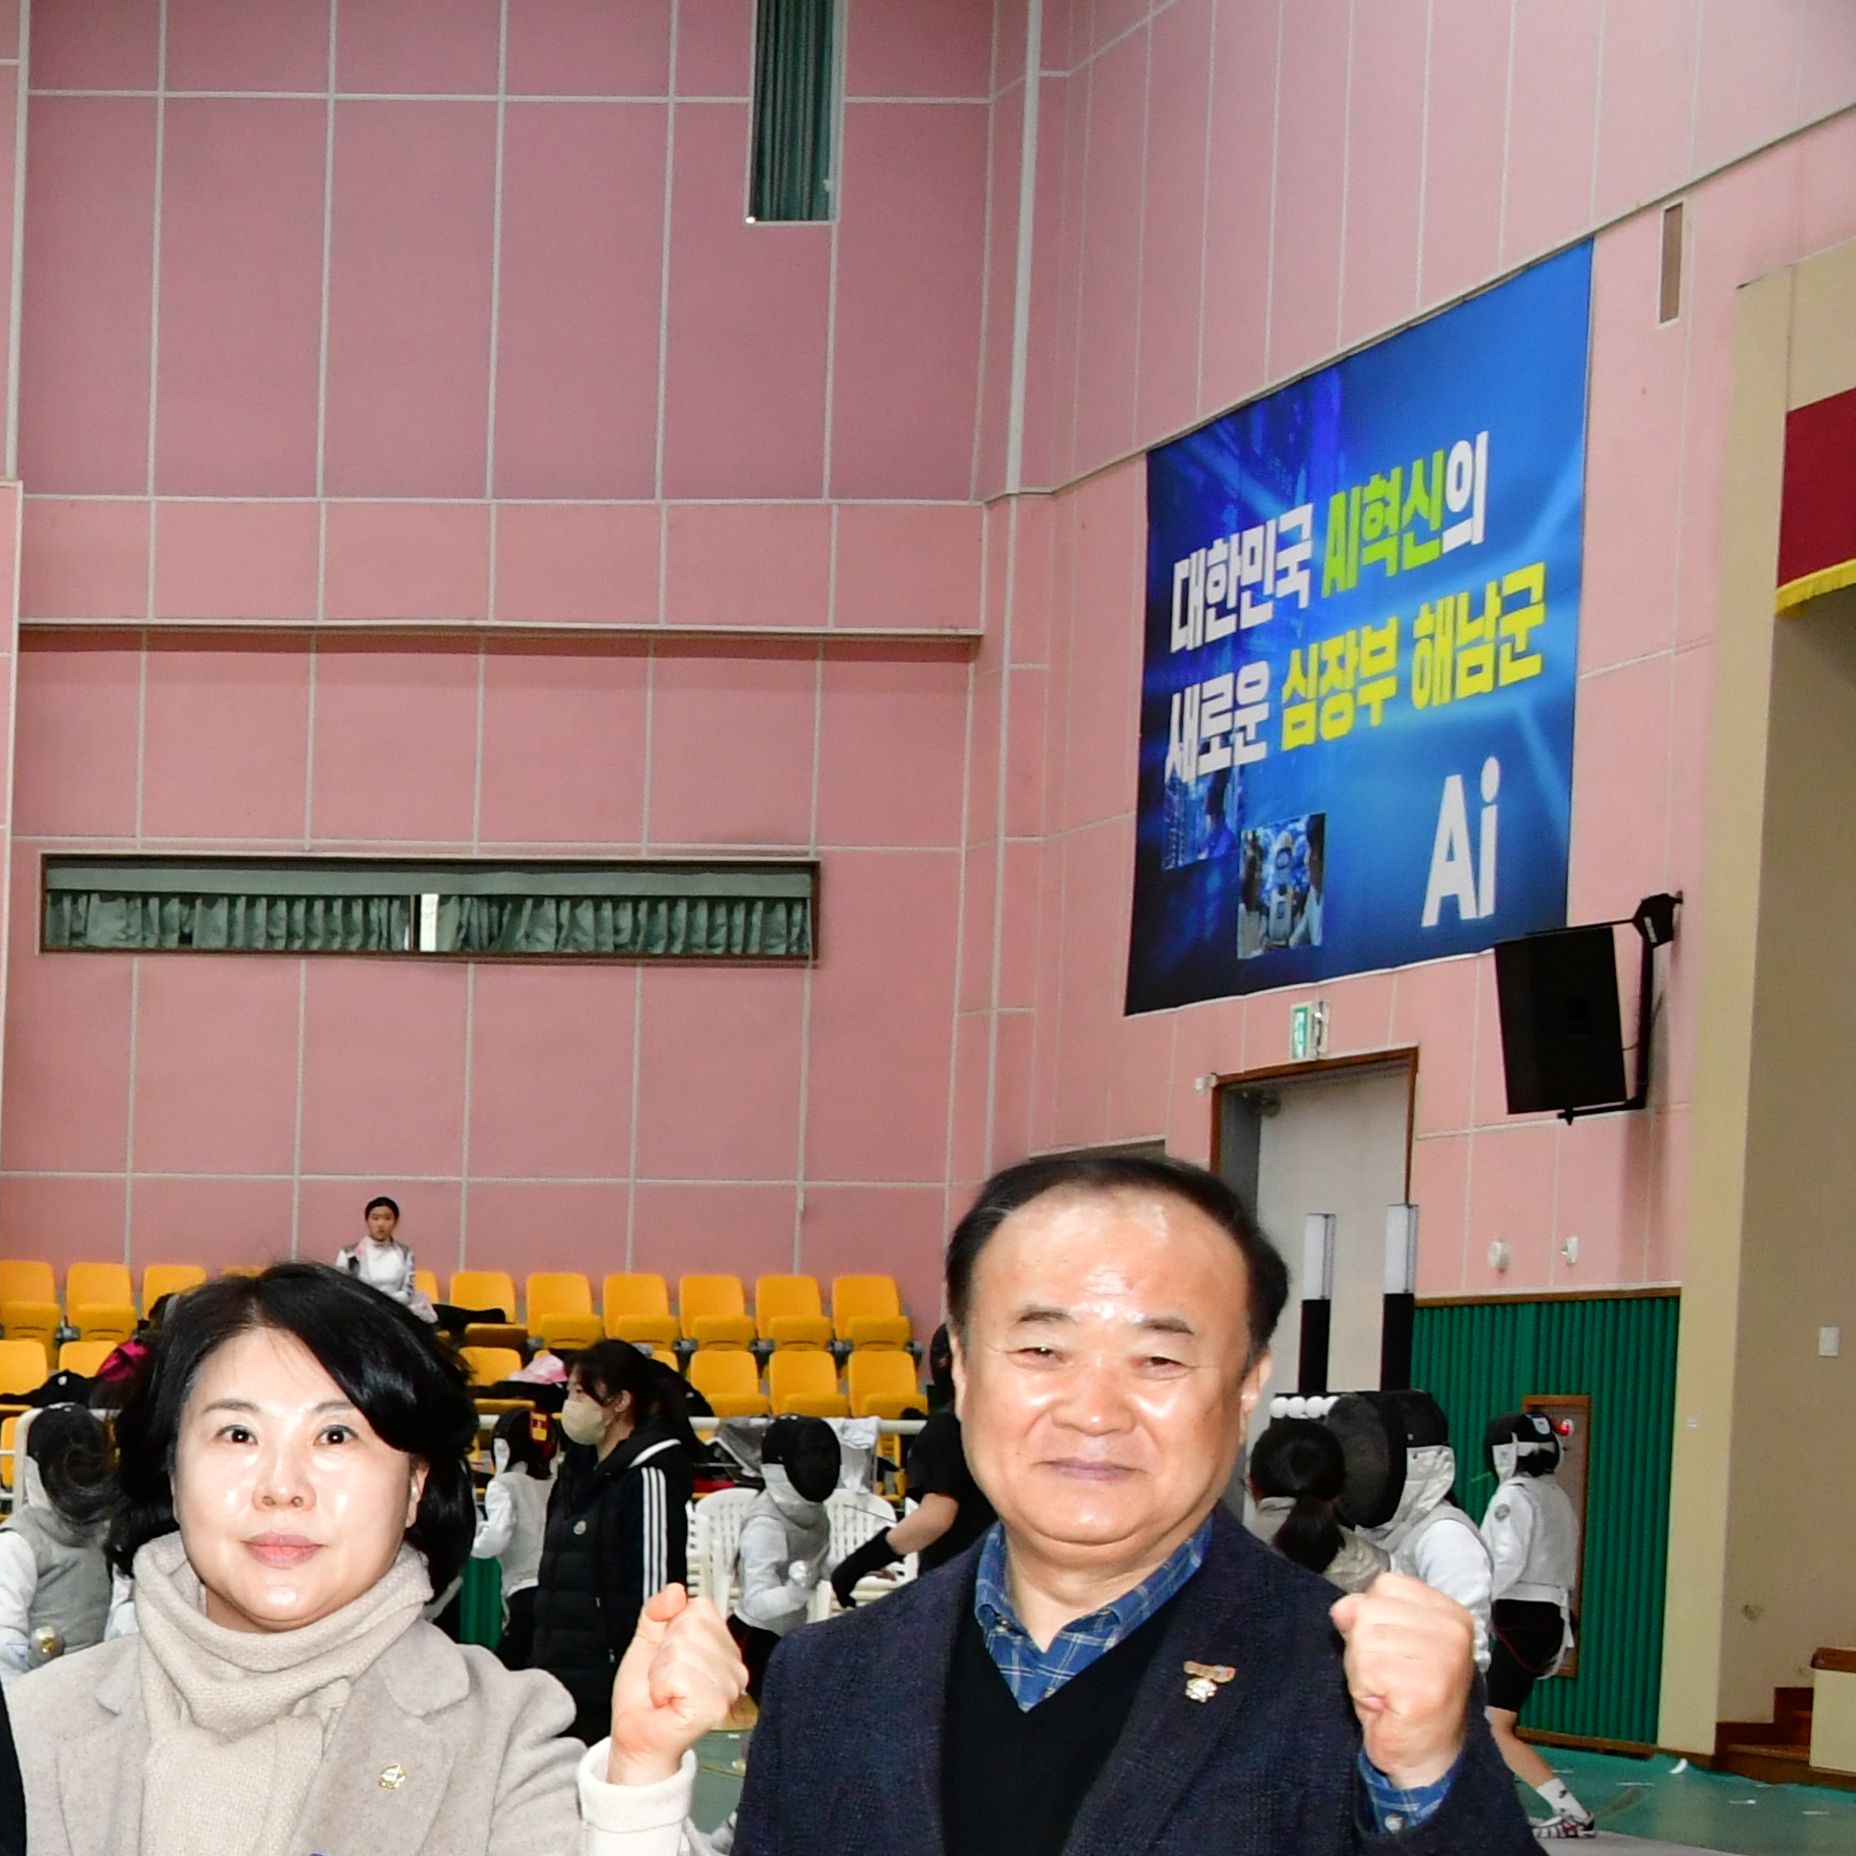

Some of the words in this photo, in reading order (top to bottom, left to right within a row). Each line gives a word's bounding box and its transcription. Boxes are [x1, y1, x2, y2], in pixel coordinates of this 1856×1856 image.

[1170, 503, 1314, 653] 대한민국
[1164, 659, 1271, 786] 새로운
[1280, 615, 1399, 752] 심장부
[1410, 561, 1547, 711] 해남군
